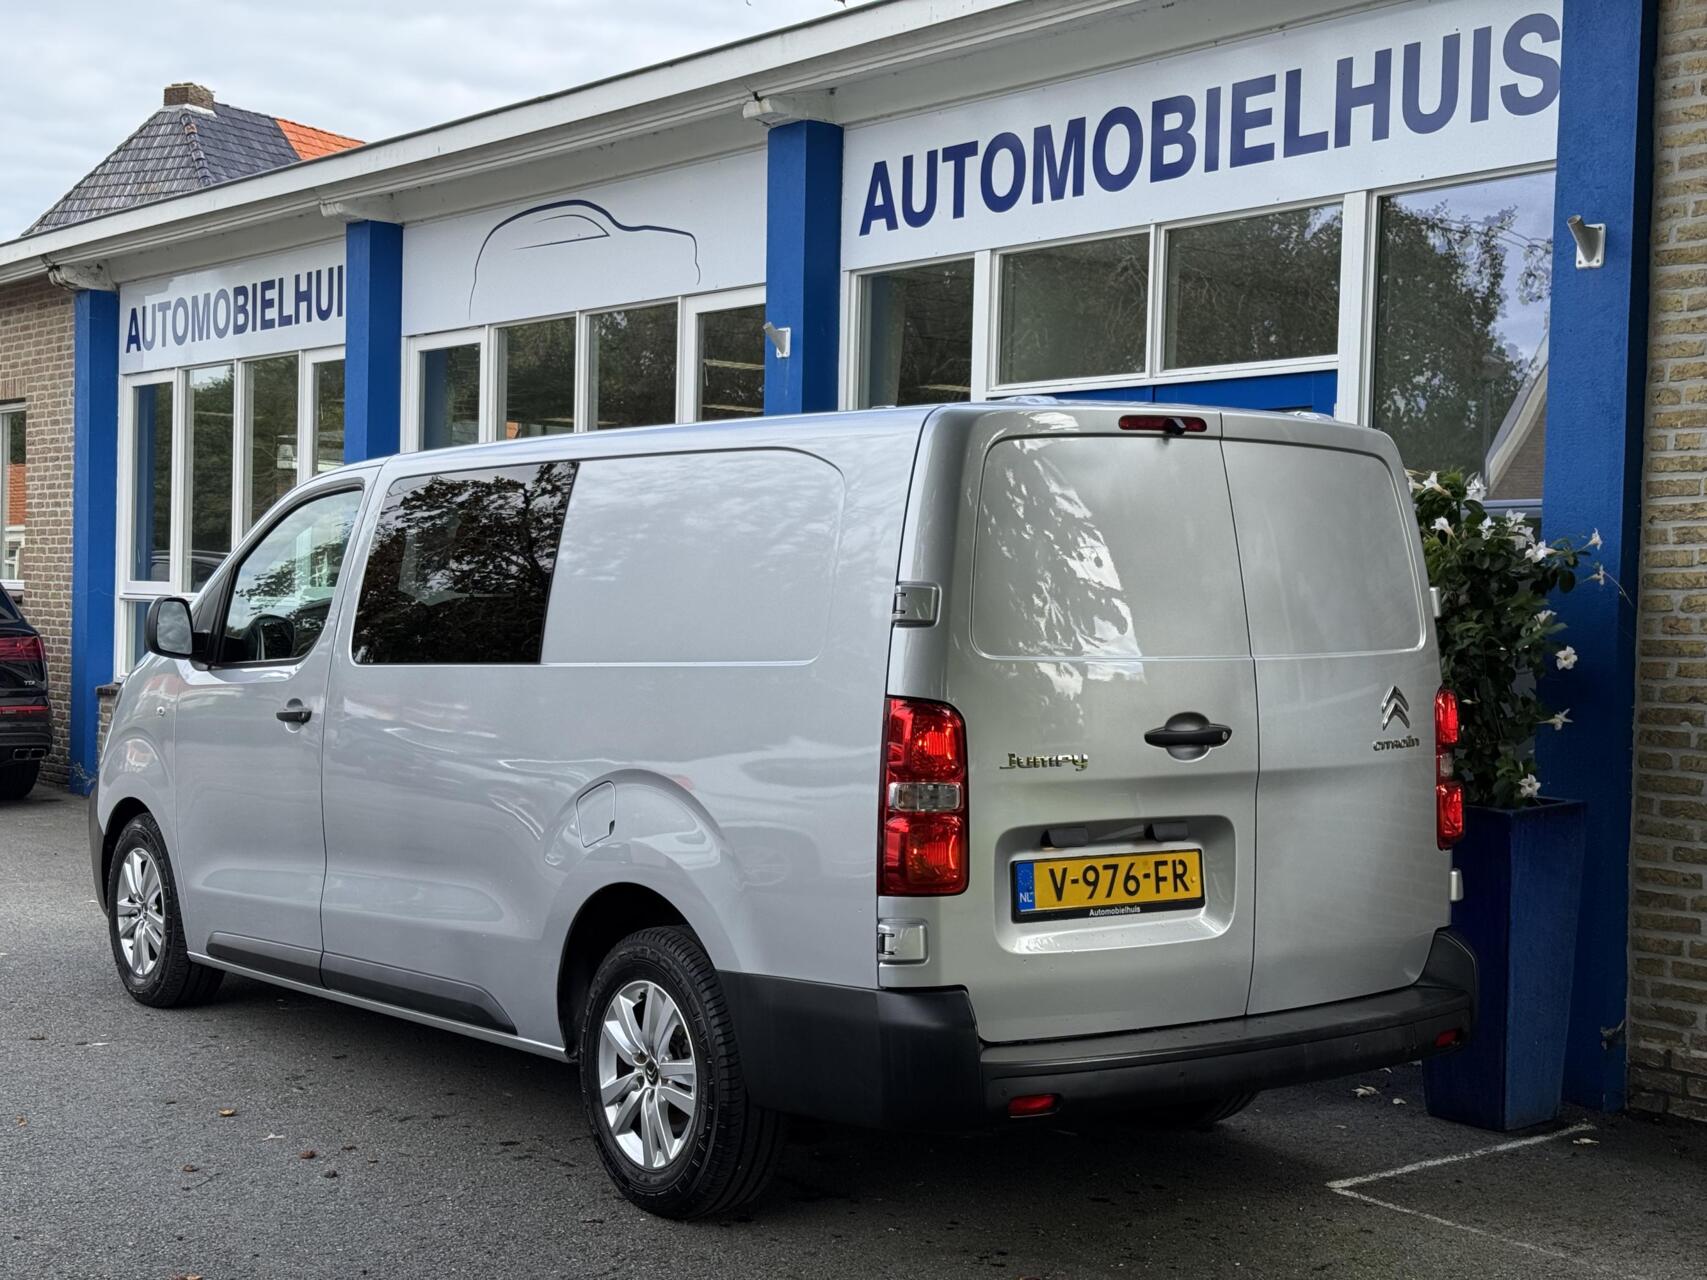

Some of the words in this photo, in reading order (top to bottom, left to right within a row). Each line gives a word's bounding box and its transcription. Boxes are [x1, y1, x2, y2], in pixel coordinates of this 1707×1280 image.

[859, 12, 1561, 237] AUTOMOBIELHUIS
[1048, 858, 1190, 902] V-976-FR
[1019, 890, 1033, 903] NL
[1089, 904, 1141, 917] Automobielhuis
